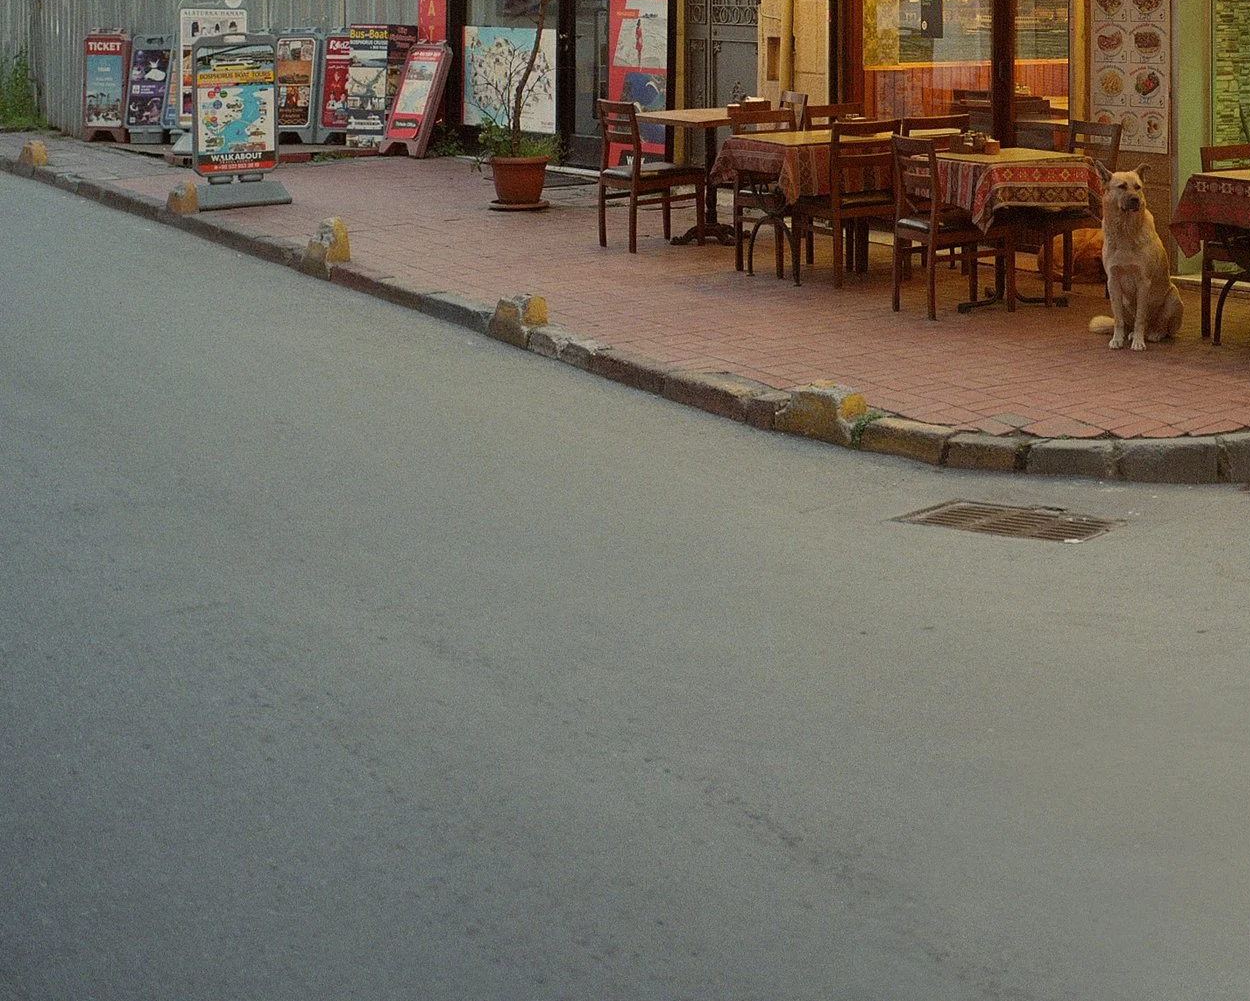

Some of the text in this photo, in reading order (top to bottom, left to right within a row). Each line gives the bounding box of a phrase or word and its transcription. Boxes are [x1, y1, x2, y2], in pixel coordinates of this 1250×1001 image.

[350, 28, 389, 40] Bus-Boat
[88, 42, 122, 51] TICKET
[200, 72, 233, 80] BOSPHORUS
[235, 71, 250, 79] BOAT
